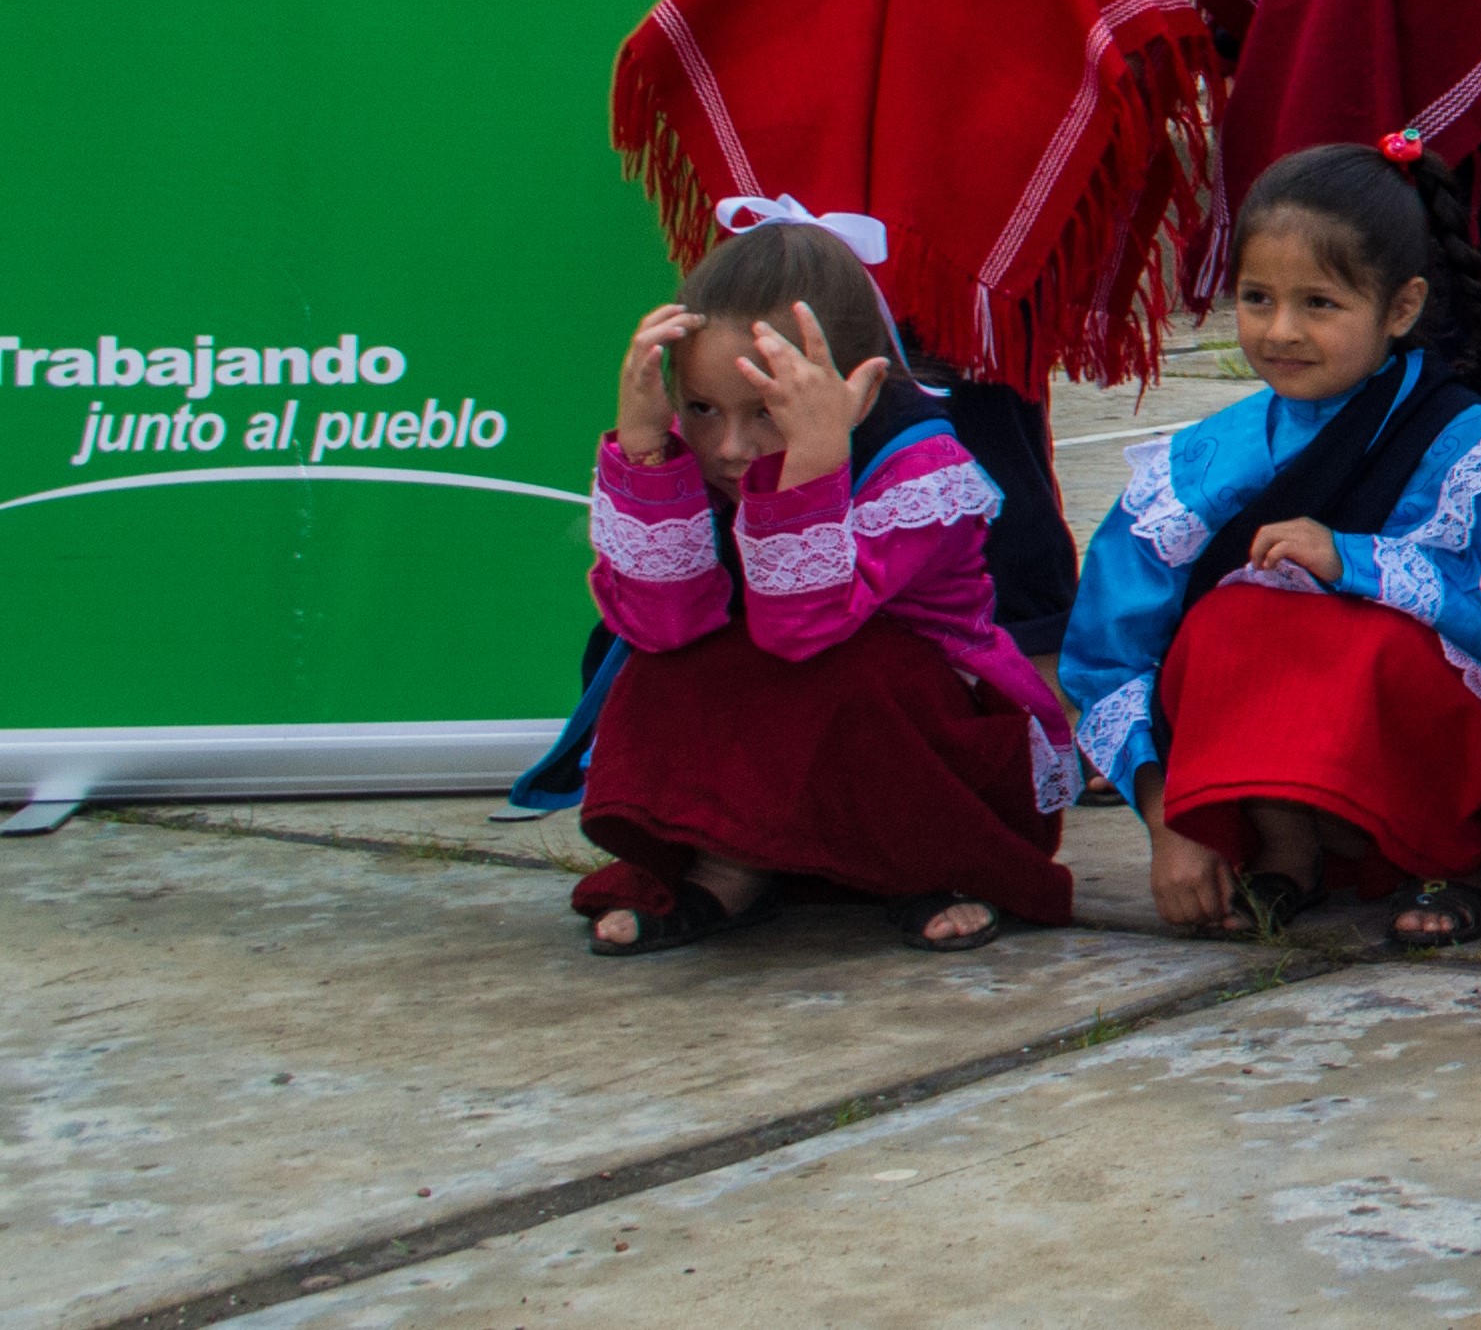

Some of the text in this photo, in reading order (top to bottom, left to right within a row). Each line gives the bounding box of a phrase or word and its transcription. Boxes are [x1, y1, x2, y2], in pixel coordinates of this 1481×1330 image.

[69, 397, 507, 467] junto al pueblo
